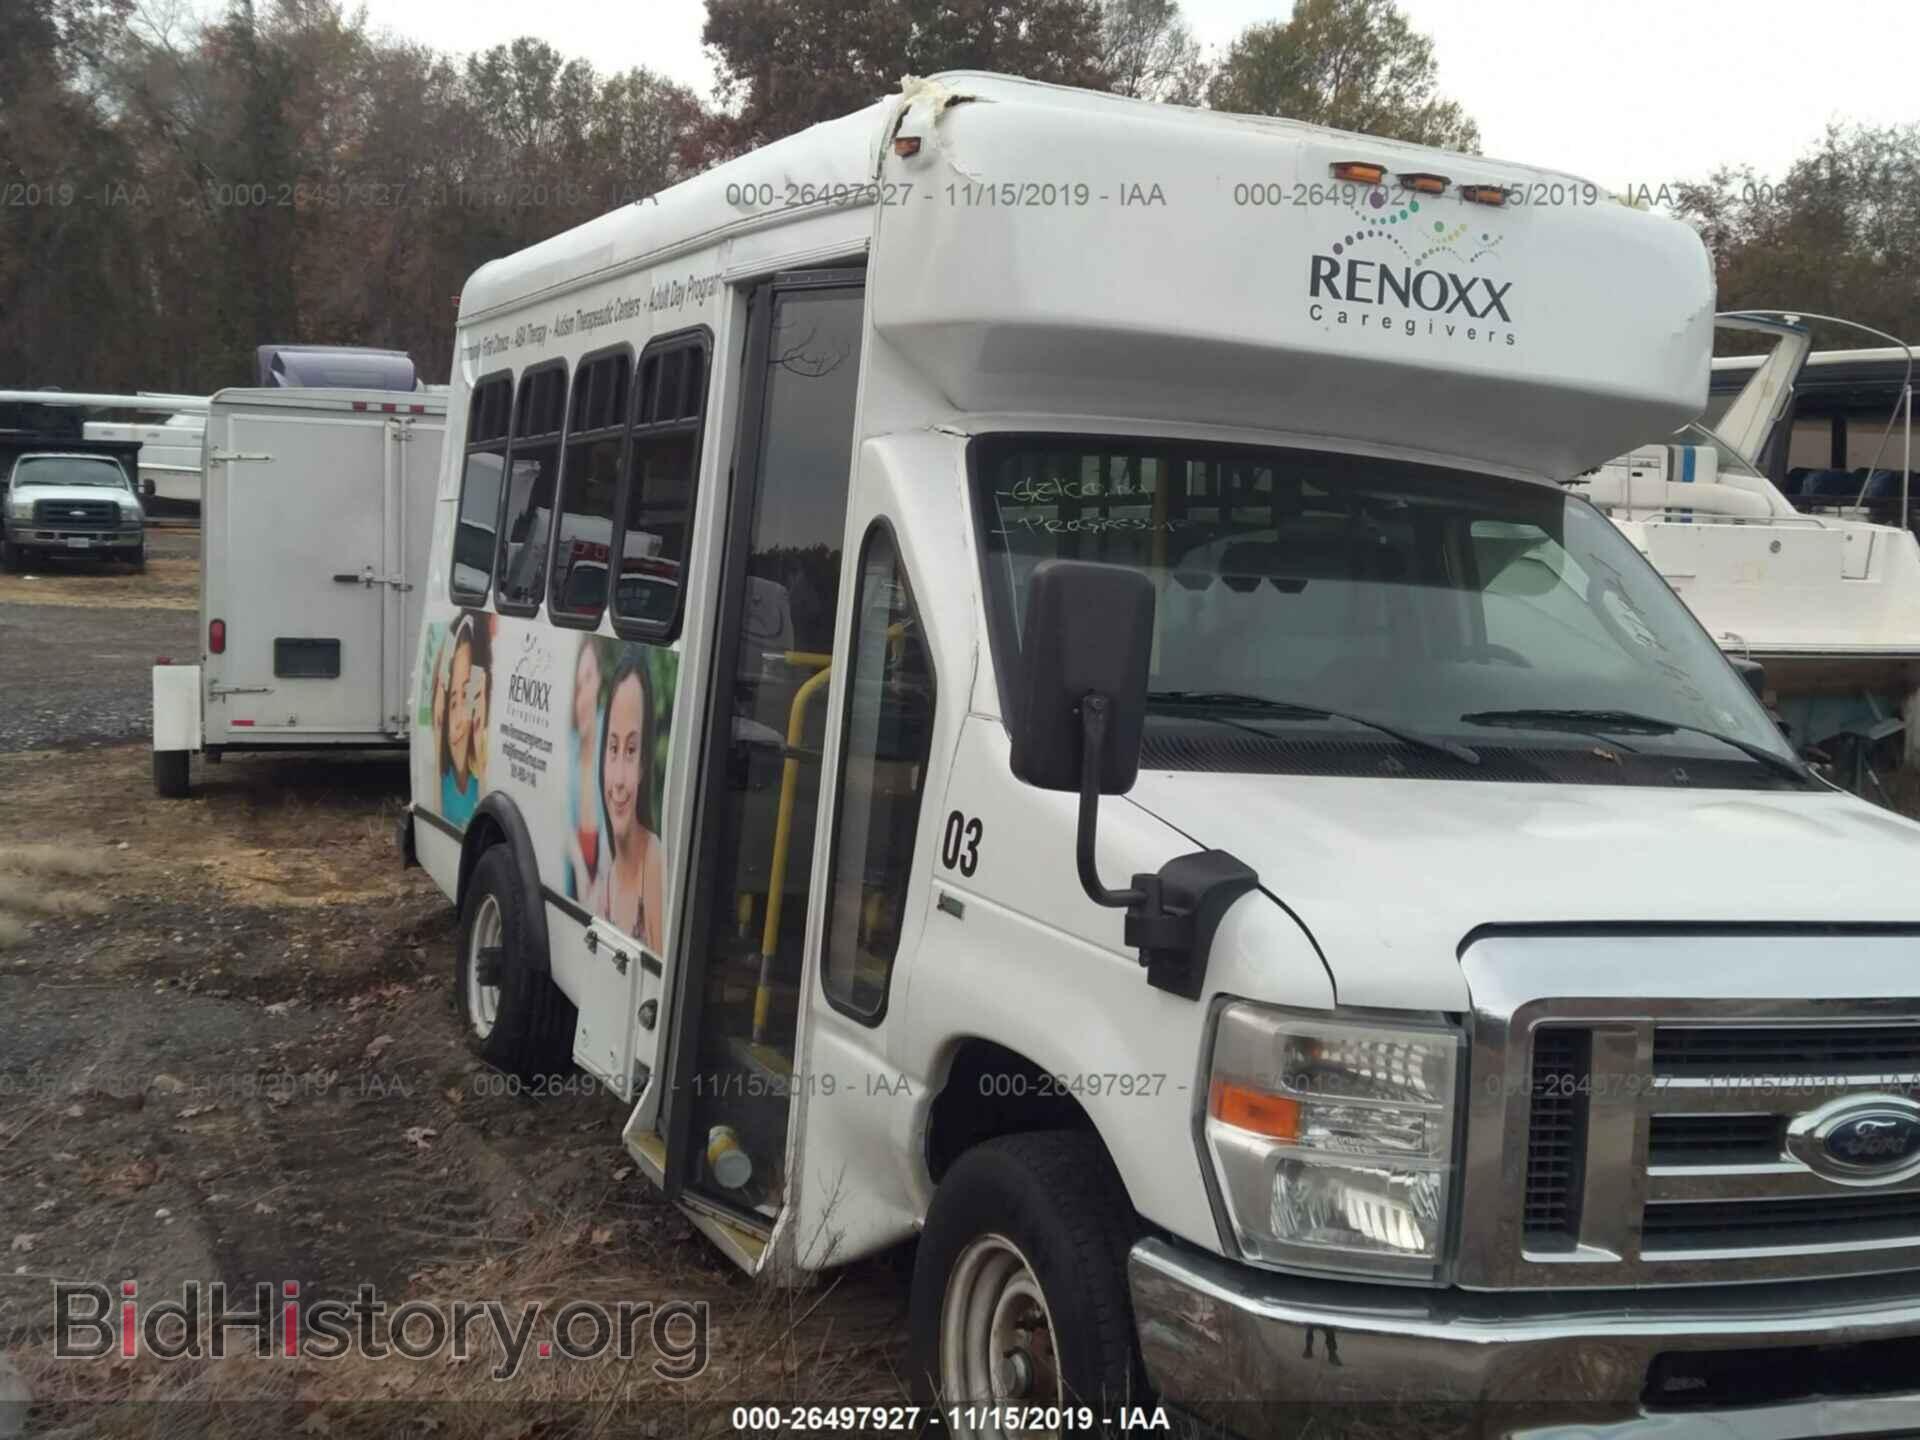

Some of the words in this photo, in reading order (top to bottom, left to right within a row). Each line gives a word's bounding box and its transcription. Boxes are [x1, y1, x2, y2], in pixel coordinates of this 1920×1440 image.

[614, 297, 641, 323] Centers
[648, 279, 670, 312] Adult
[669, 279, 687, 313] Day
[686, 273, 722, 308] Program
[1309, 255, 1513, 323] RENOXX
[1309, 303, 1516, 346] Caregivers
[508, 674, 552, 713] RENOXX
[941, 809, 984, 878] 03
[1843, 1119, 1915, 1156] Ford
